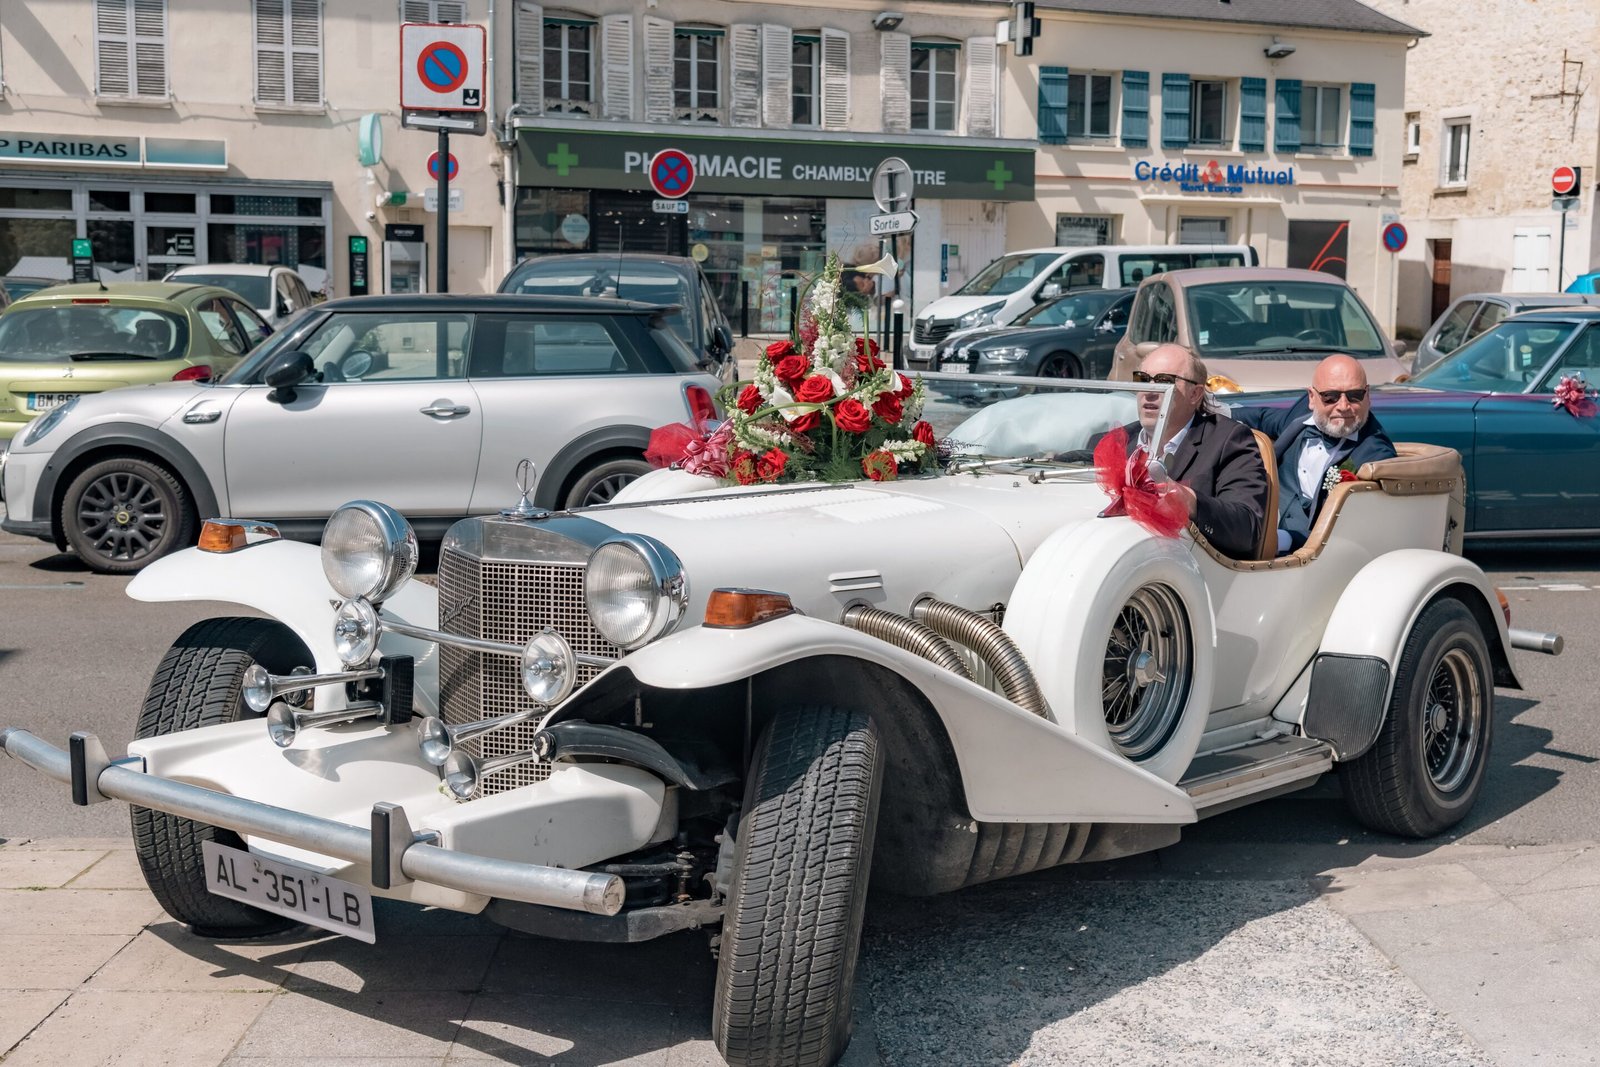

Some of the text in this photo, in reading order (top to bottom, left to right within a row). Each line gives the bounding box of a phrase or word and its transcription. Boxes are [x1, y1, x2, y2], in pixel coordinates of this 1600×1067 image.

[18, 140, 127, 158] PARIBAS
[792, 164, 874, 182] CHAMBLY
[1135, 161, 1293, 185] Crédit Mutuel
[1180, 182, 1243, 195] Nord Europe
[656, 202, 675, 210] SAUF
[873, 217, 900, 231] Sortie
[217, 854, 361, 926] AL-351-LB
